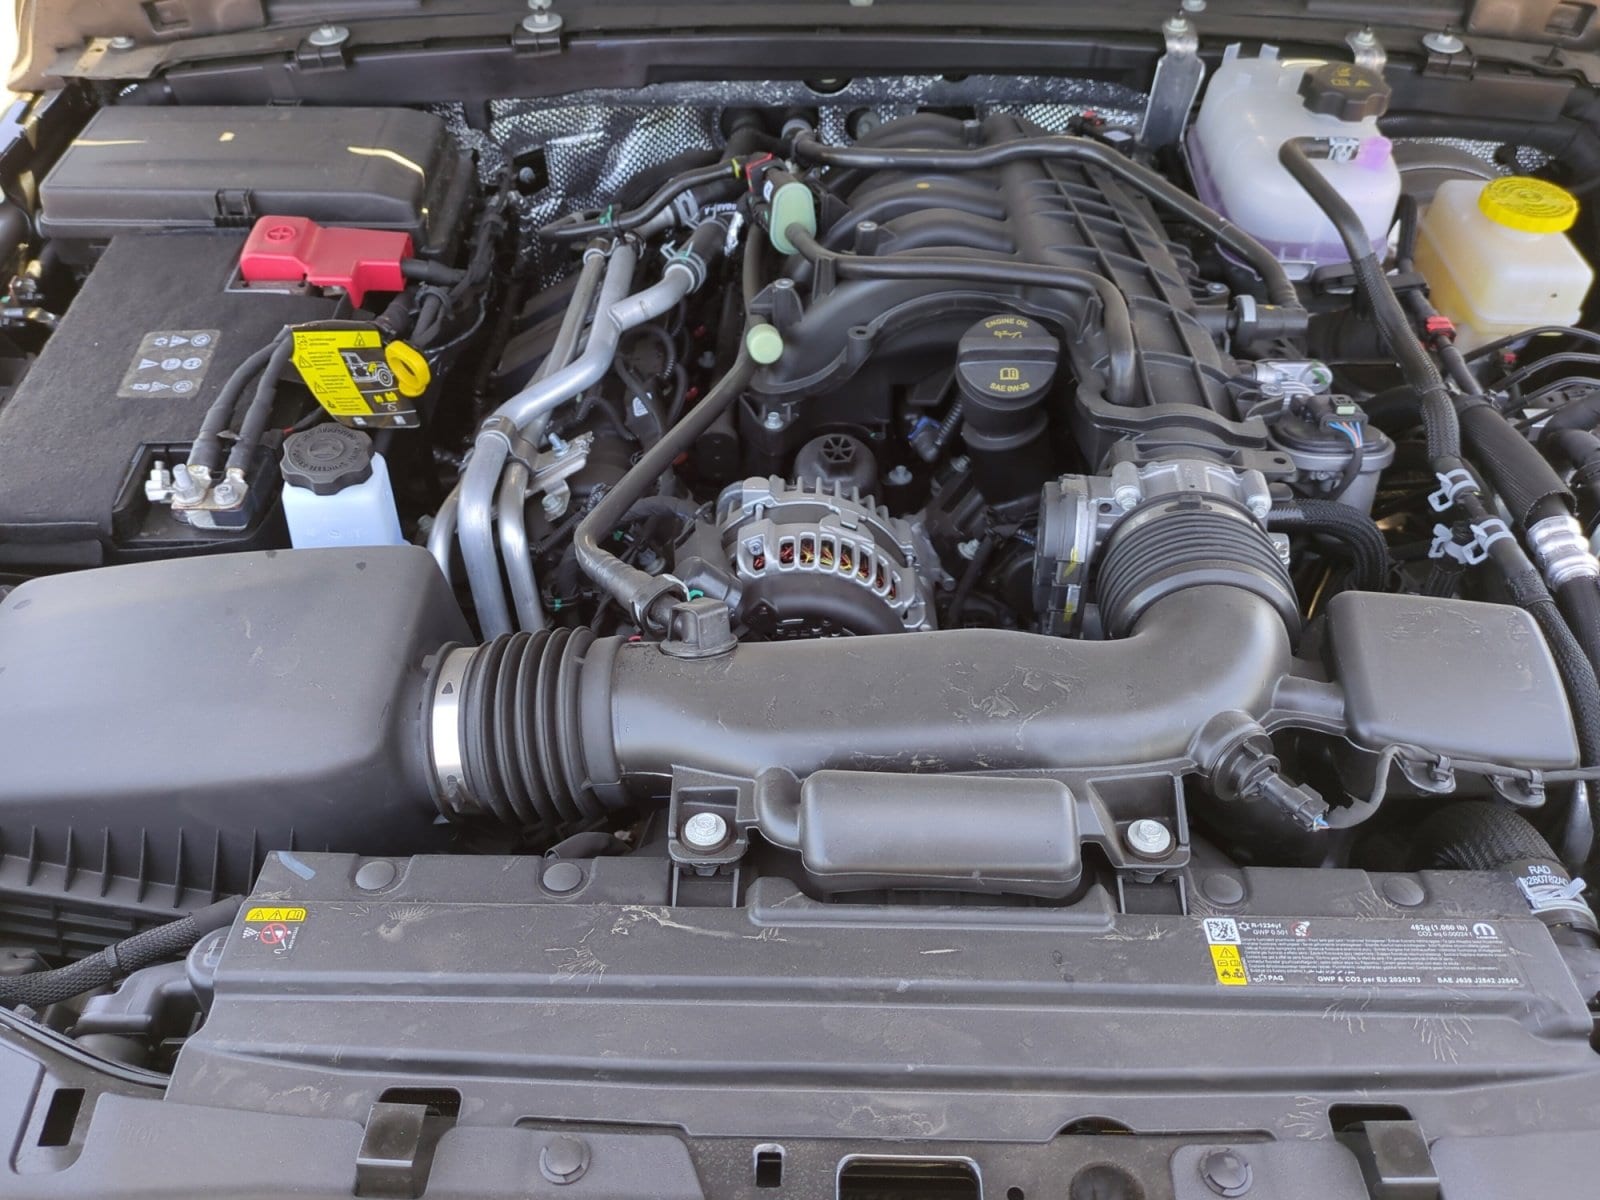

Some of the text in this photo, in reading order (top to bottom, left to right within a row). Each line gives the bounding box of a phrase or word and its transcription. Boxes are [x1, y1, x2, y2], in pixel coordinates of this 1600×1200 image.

[985, 318, 1029, 328] ENGINE OIL
[990, 382, 1007, 391] SAE
[1528, 865, 1551, 875] RAD
[1317, 975, 1336, 983] GWP
